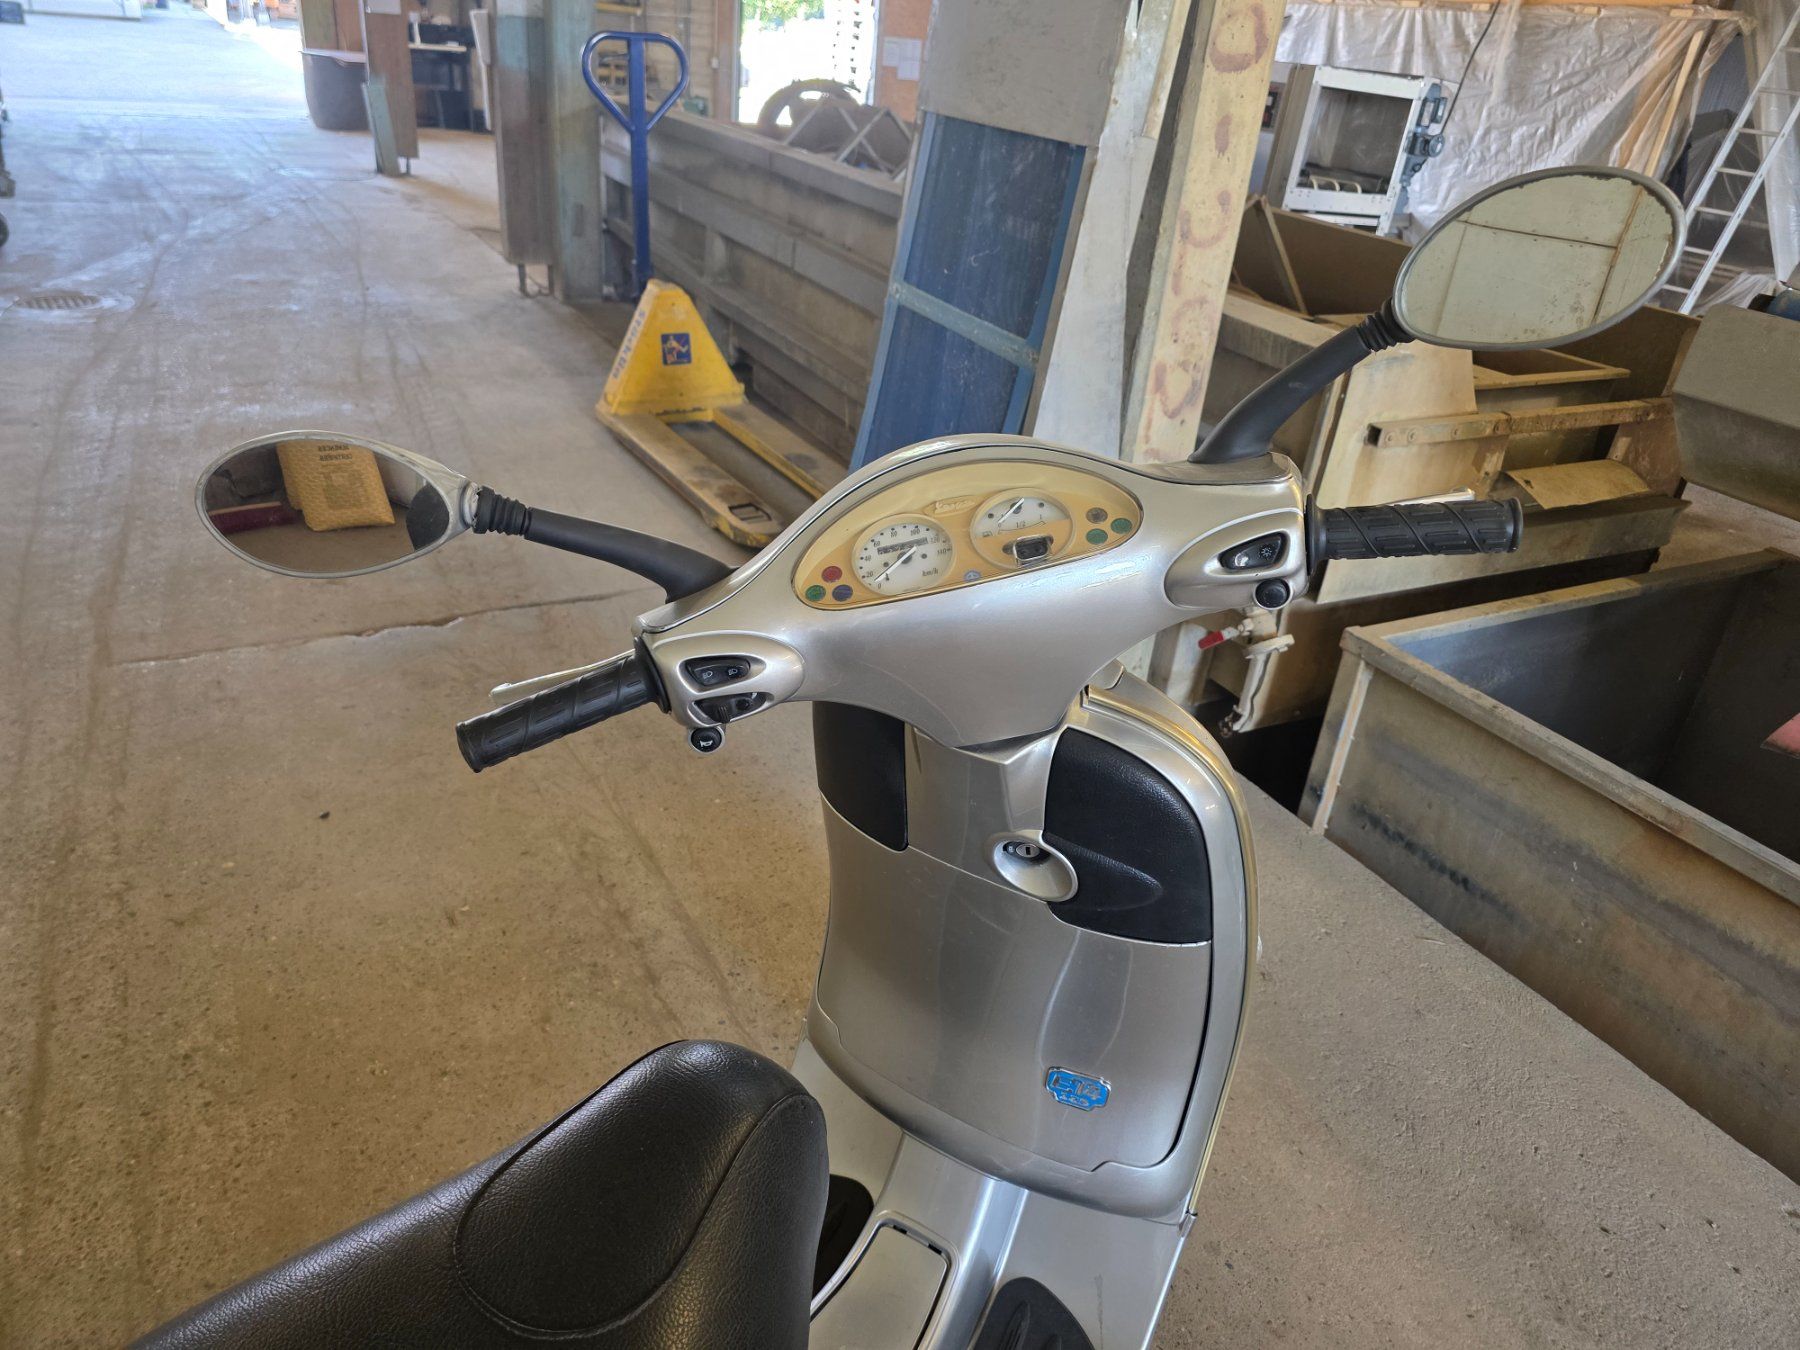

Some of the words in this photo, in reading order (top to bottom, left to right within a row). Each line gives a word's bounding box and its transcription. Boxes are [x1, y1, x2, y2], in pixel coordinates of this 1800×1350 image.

[910, 528, 921, 536] 100
[866, 570, 874, 578] 20
[922, 567, 939, 577] km/h
